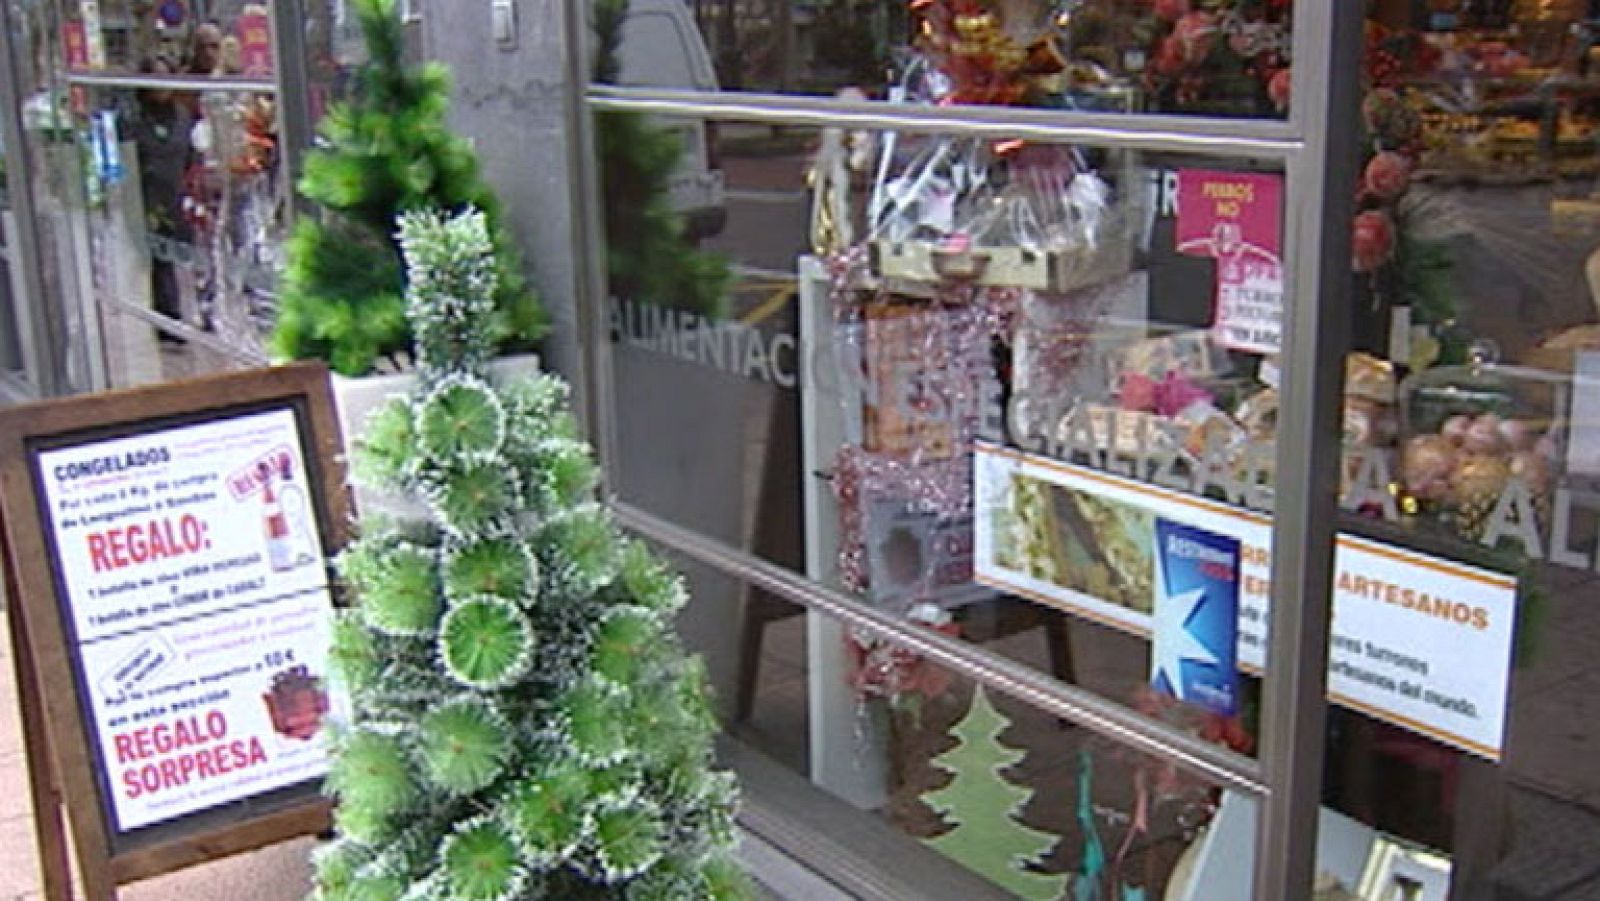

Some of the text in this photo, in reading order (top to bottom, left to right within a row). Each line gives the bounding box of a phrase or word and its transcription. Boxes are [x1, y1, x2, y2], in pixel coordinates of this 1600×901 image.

[1216, 200, 1240, 216] NO
[54, 446, 170, 481] CONGELADOS
[86, 513, 212, 573] REGALO:
[1336, 570, 1490, 631] ARTESANOS
[114, 709, 228, 764] REGALO
[122, 736, 268, 800] SORPRESA
